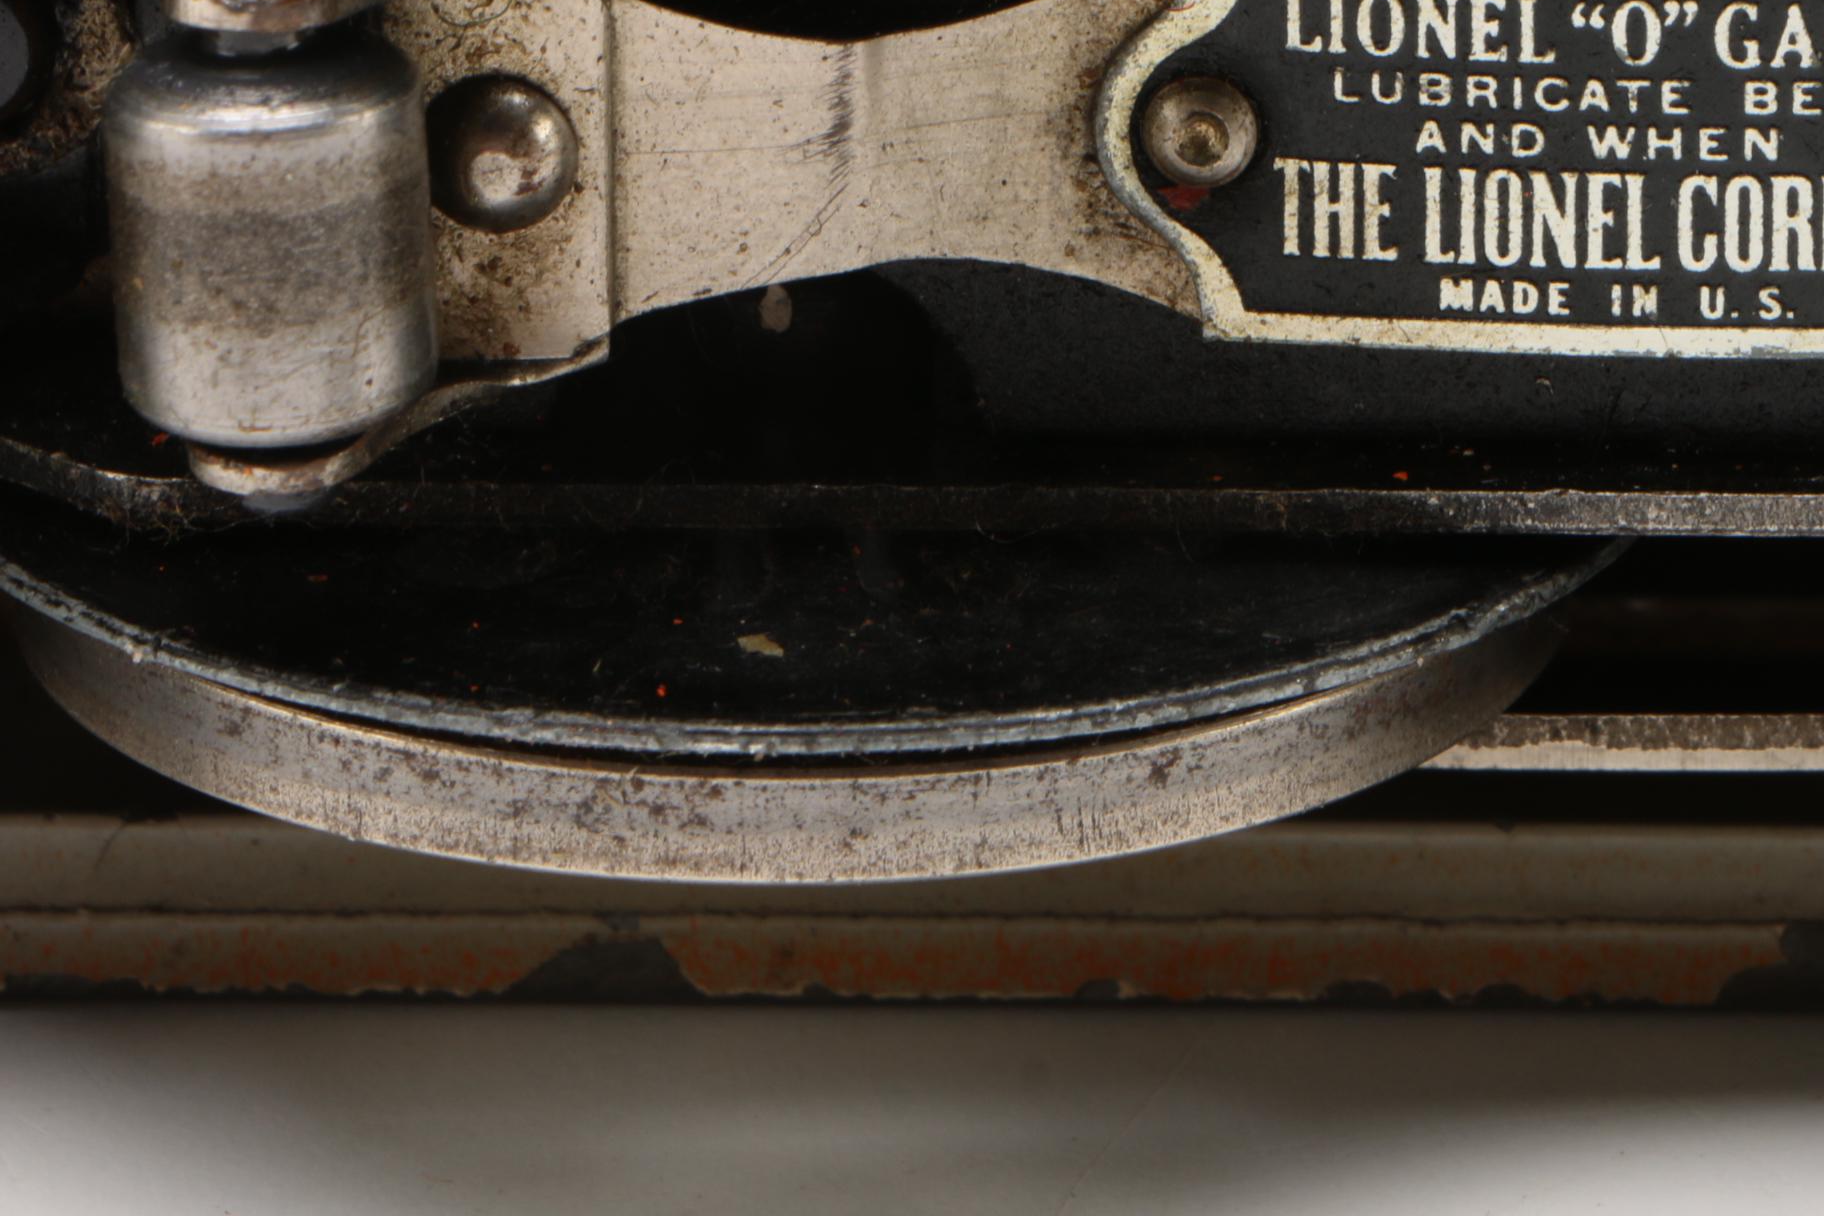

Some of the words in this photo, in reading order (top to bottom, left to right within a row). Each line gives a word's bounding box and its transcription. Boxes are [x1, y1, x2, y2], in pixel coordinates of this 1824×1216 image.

[1334, 72, 1689, 114] LUBRICATE
[1416, 121, 1544, 157] AND
[1588, 126, 1778, 161] WHEN
[1274, 158, 1397, 261] THE
[1424, 167, 1660, 270] LIONEL
[1440, 279, 1570, 315] MADE
[1611, 285, 1657, 316] IN
